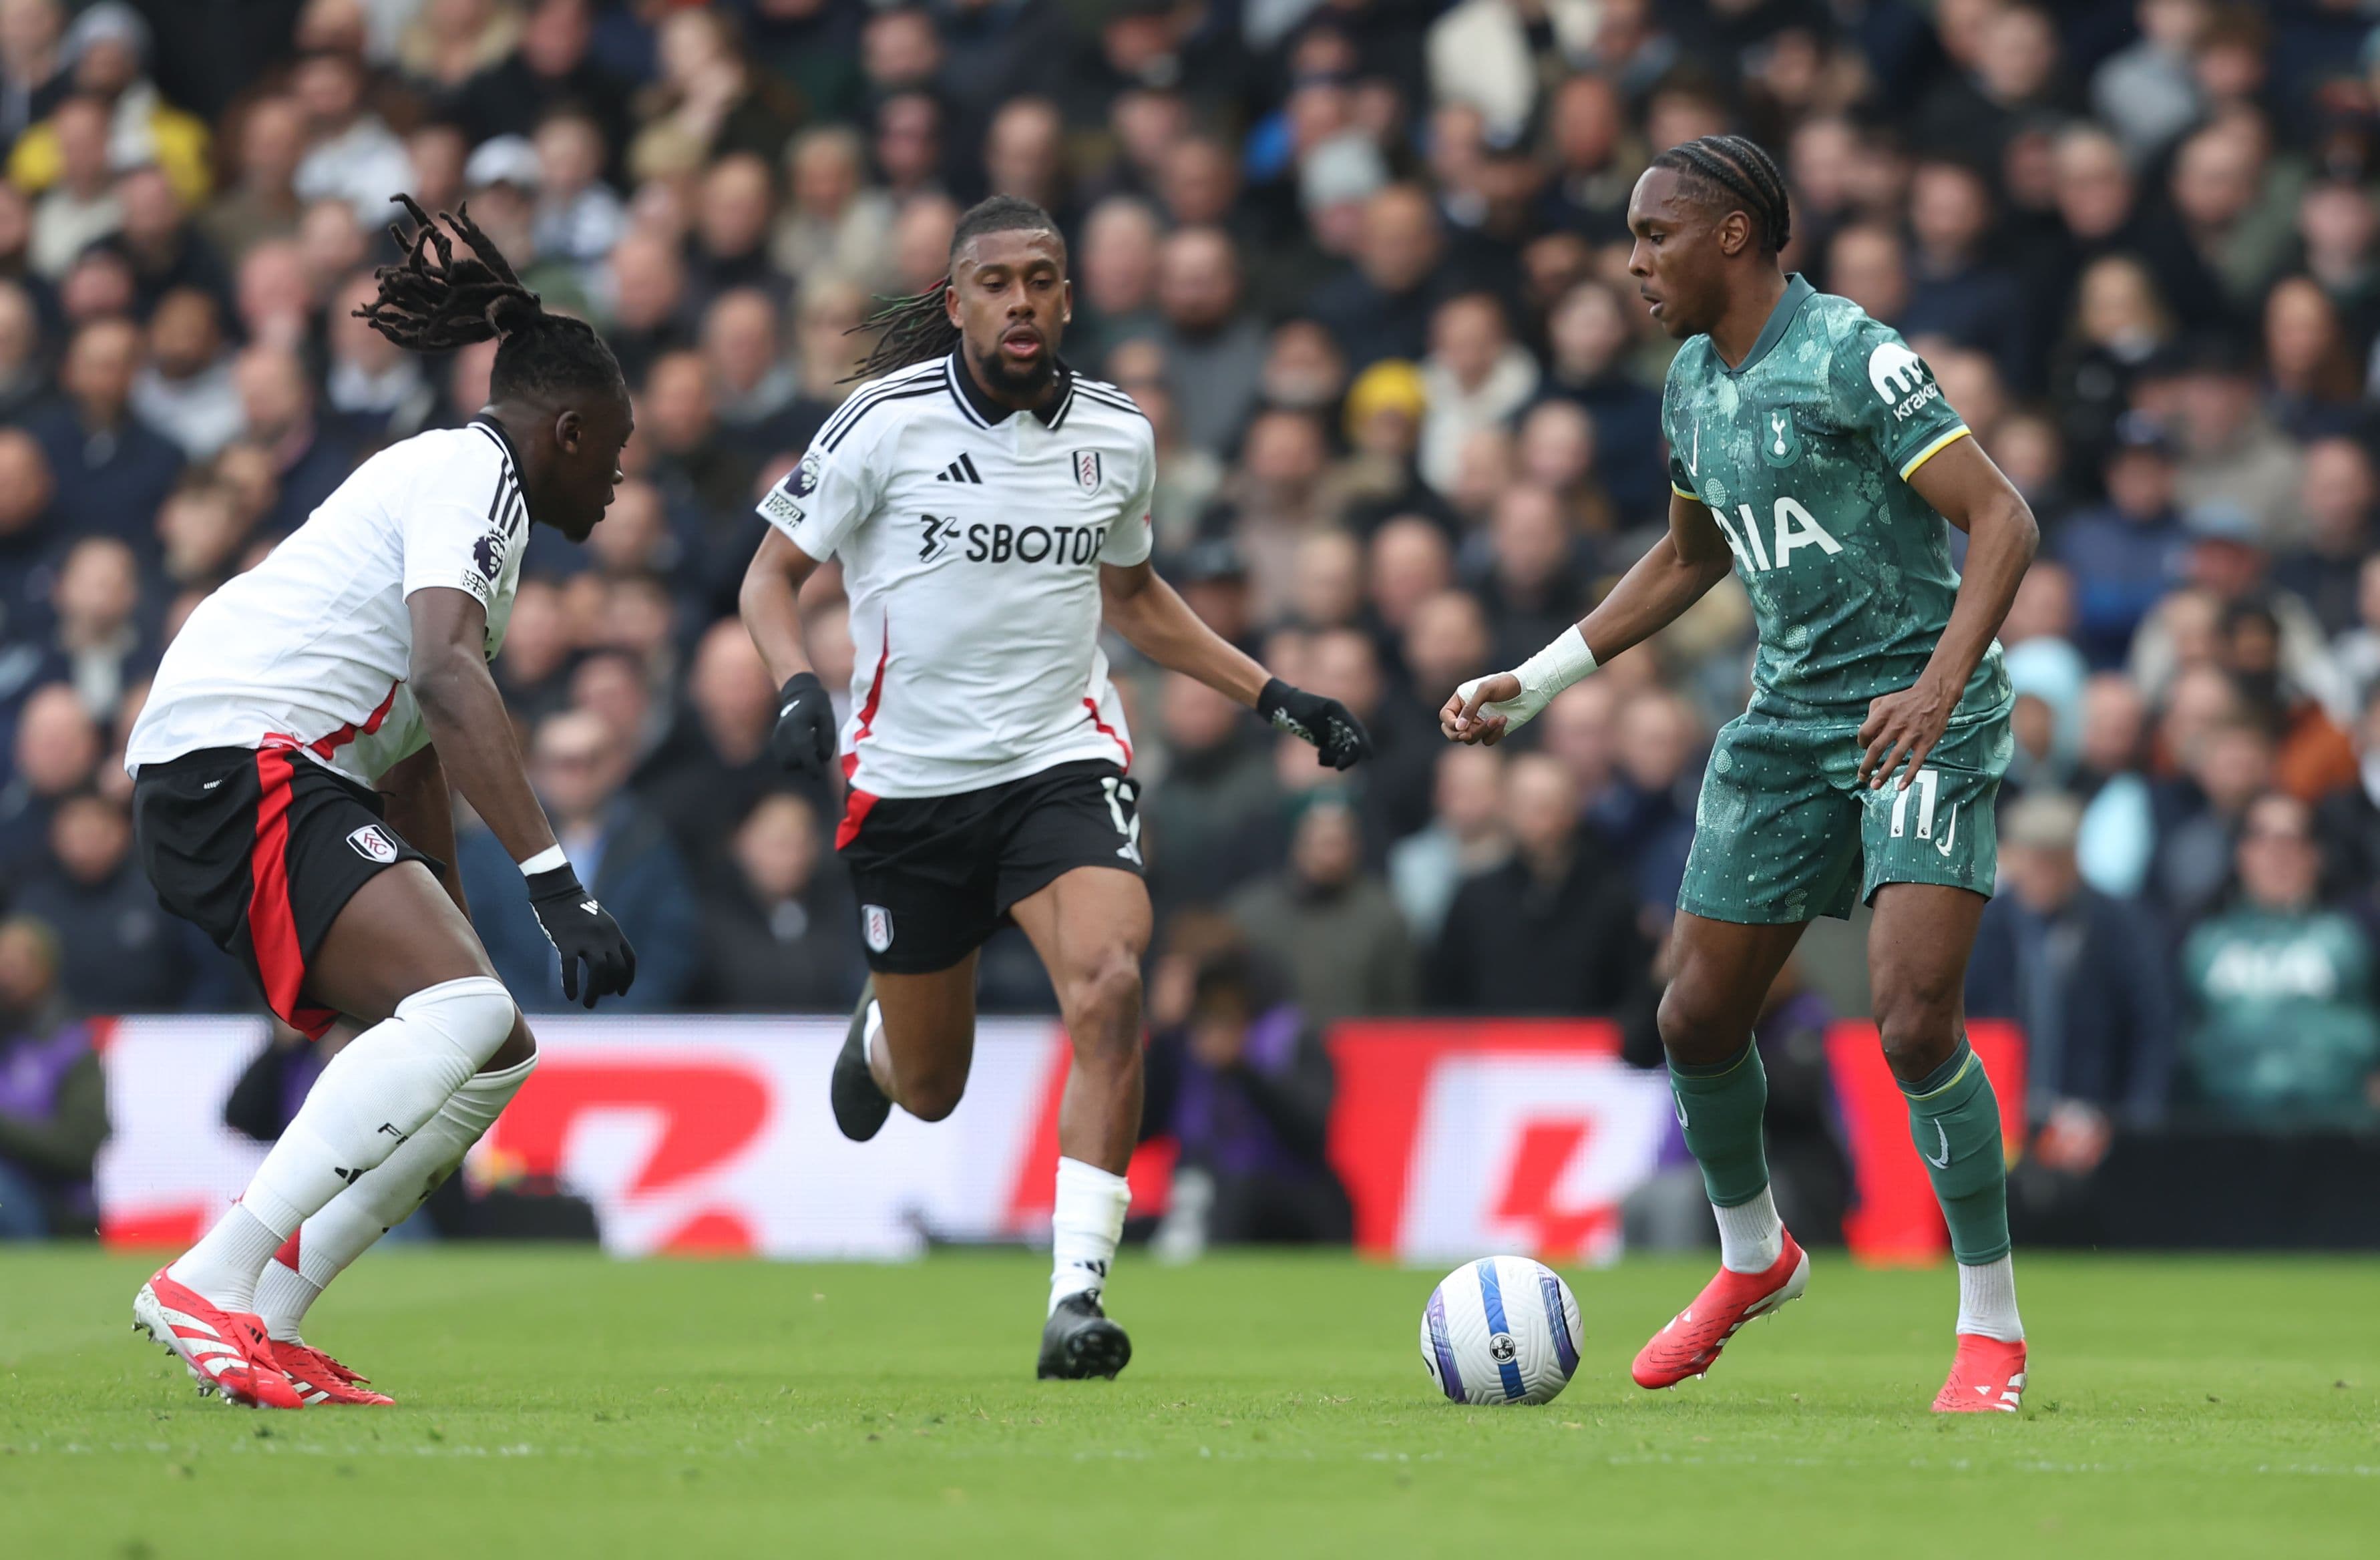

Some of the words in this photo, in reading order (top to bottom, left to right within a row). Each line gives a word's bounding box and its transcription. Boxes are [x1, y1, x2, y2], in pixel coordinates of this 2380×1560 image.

[1893, 382, 1939, 422] krake
[1710, 496, 1848, 572] AIA
[1891, 769, 1938, 839] 11
[363, 833, 387, 855] FFC
